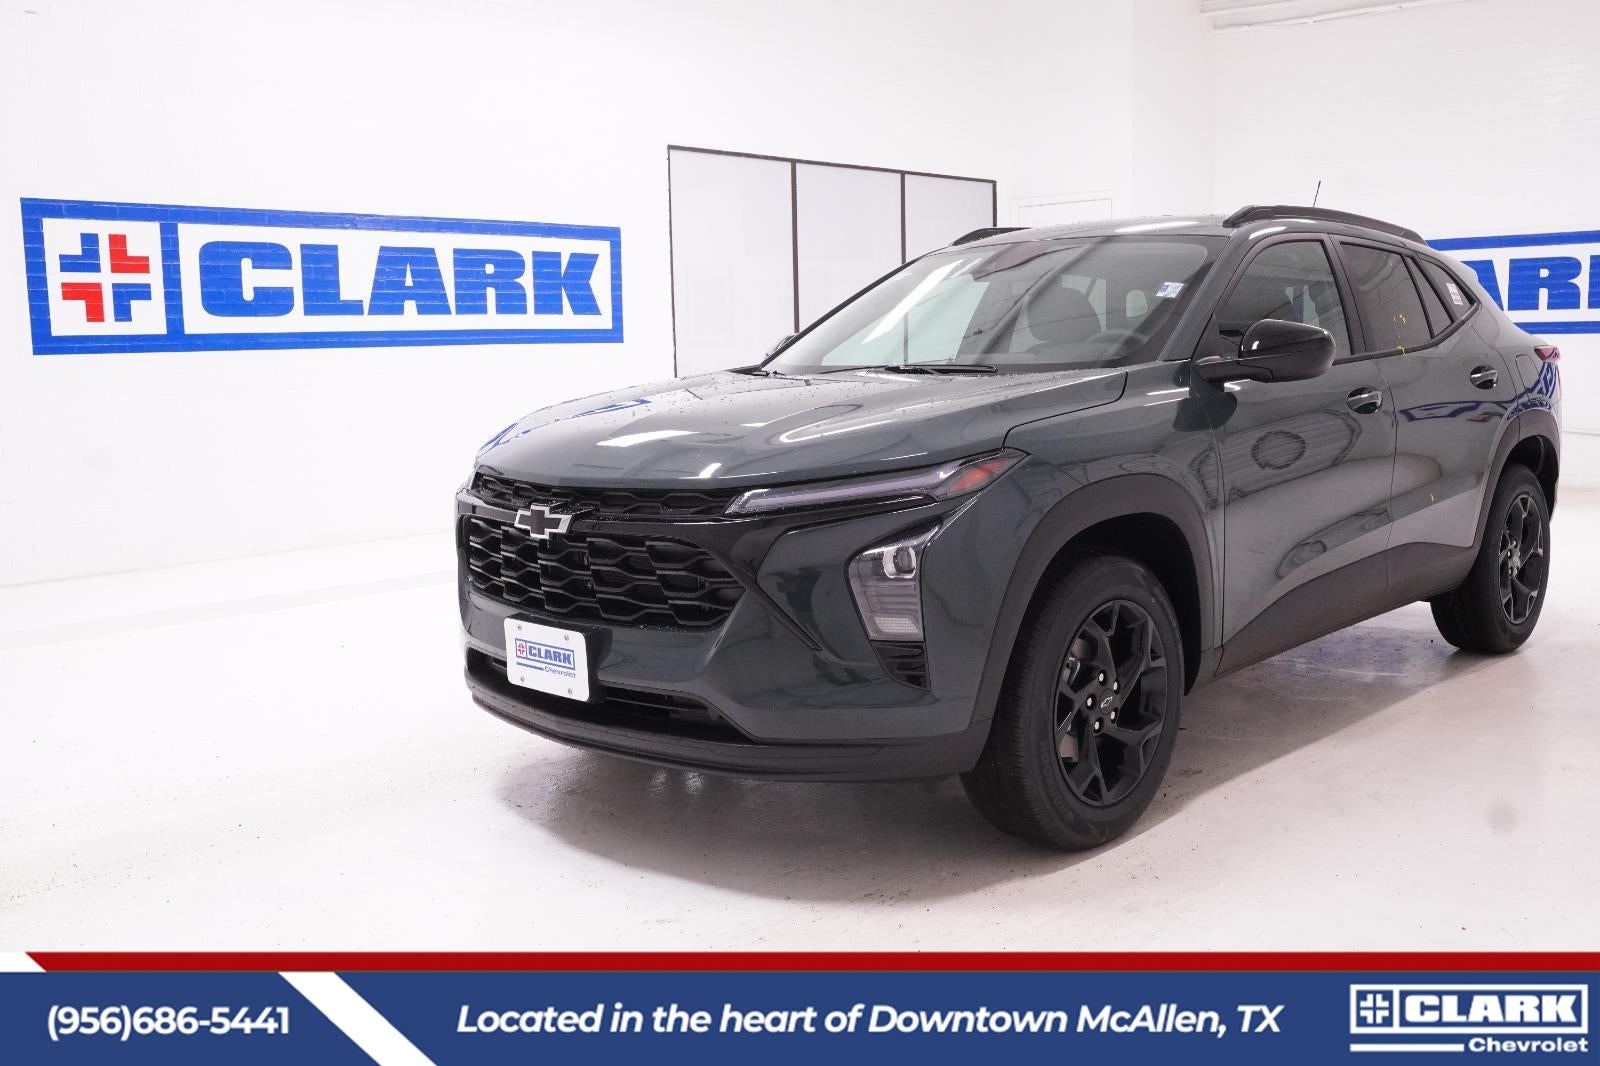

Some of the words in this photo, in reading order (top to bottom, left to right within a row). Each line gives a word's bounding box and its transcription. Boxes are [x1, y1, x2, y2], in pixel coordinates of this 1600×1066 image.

[199, 241, 602, 317] CLARK
[528, 645, 572, 664] CLARK
[544, 665, 576, 678] Chevrolet
